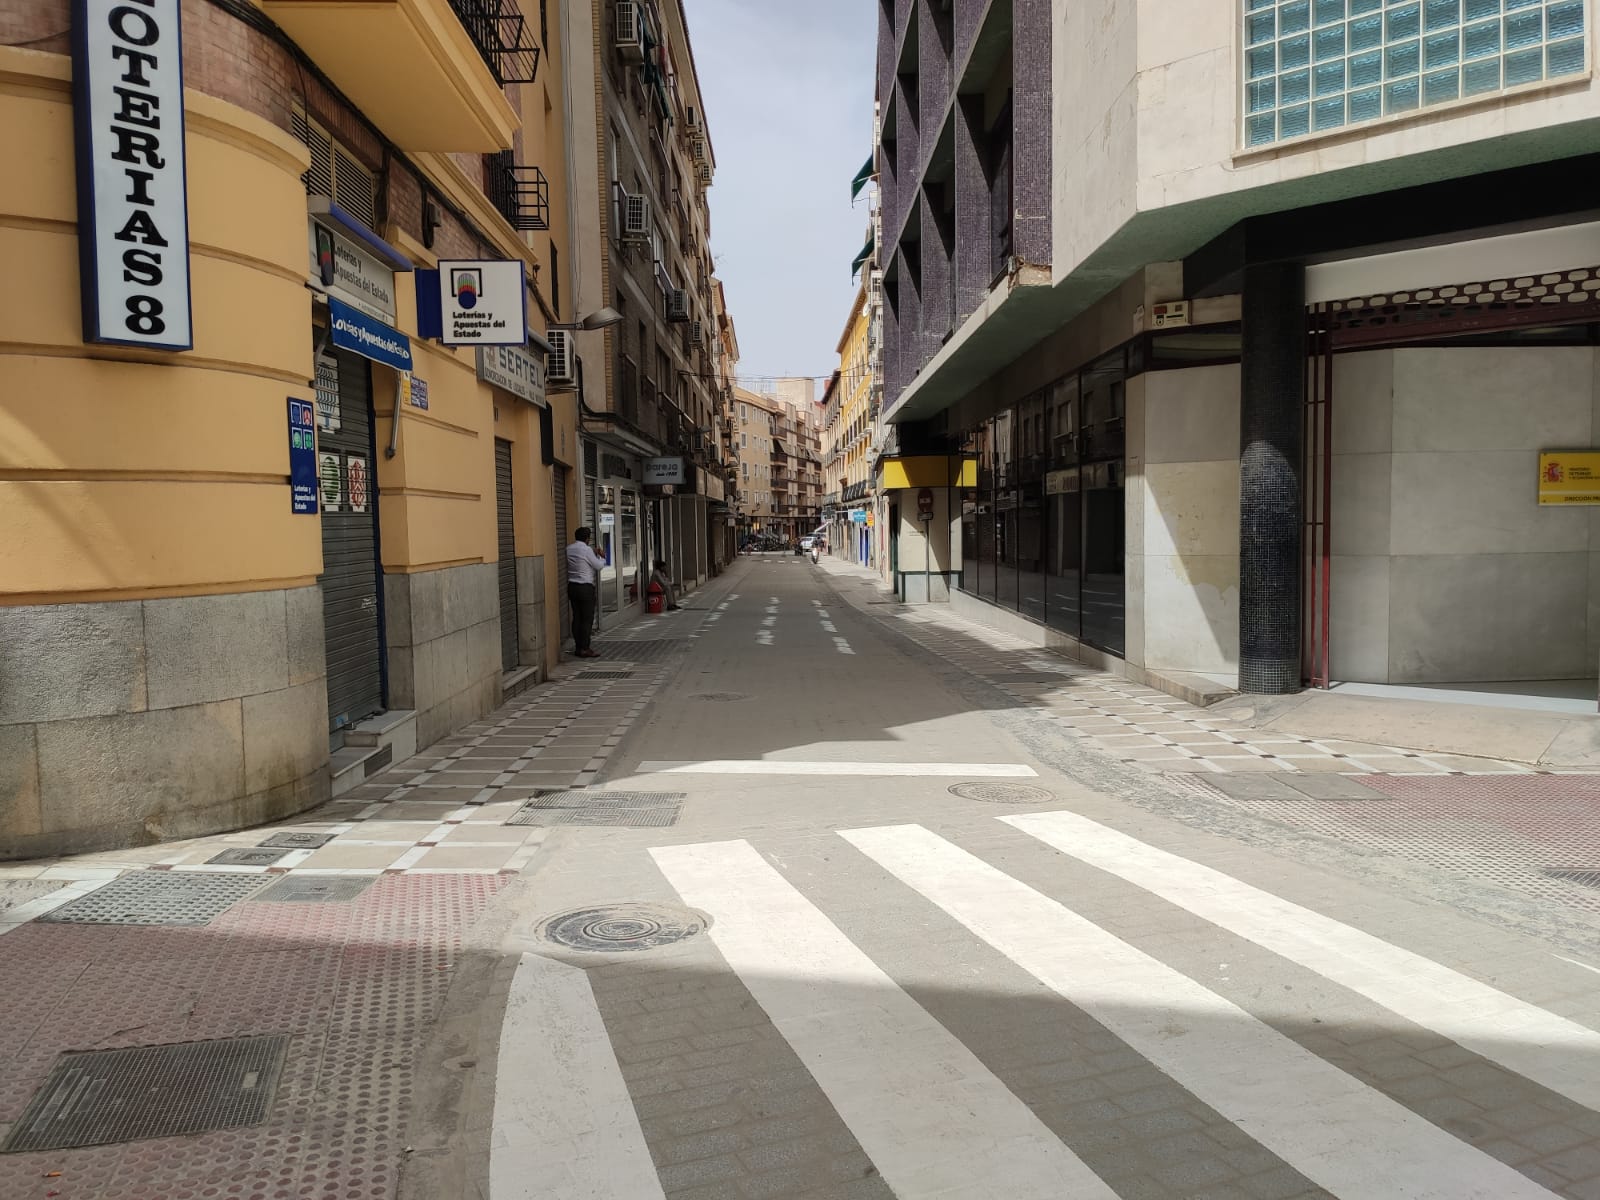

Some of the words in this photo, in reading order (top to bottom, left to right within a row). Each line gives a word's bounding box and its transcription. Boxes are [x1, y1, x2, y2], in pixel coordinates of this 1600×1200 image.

[107, 0, 169, 286] OTERIAS
[335, 261, 361, 288] Apuestas
[362, 277, 371, 293] del
[371, 283, 388, 304] Estado
[125, 295, 166, 335] 8
[452, 311, 486, 319] Loterías
[487, 312, 493, 320] y
[453, 320, 491, 330] Apuestas
[493, 320, 505, 328] del
[453, 330, 481, 338] Estado
[331, 313, 358, 337] Loías
[394, 342, 410, 359] Eso
[499, 346, 542, 389] SERTEL
